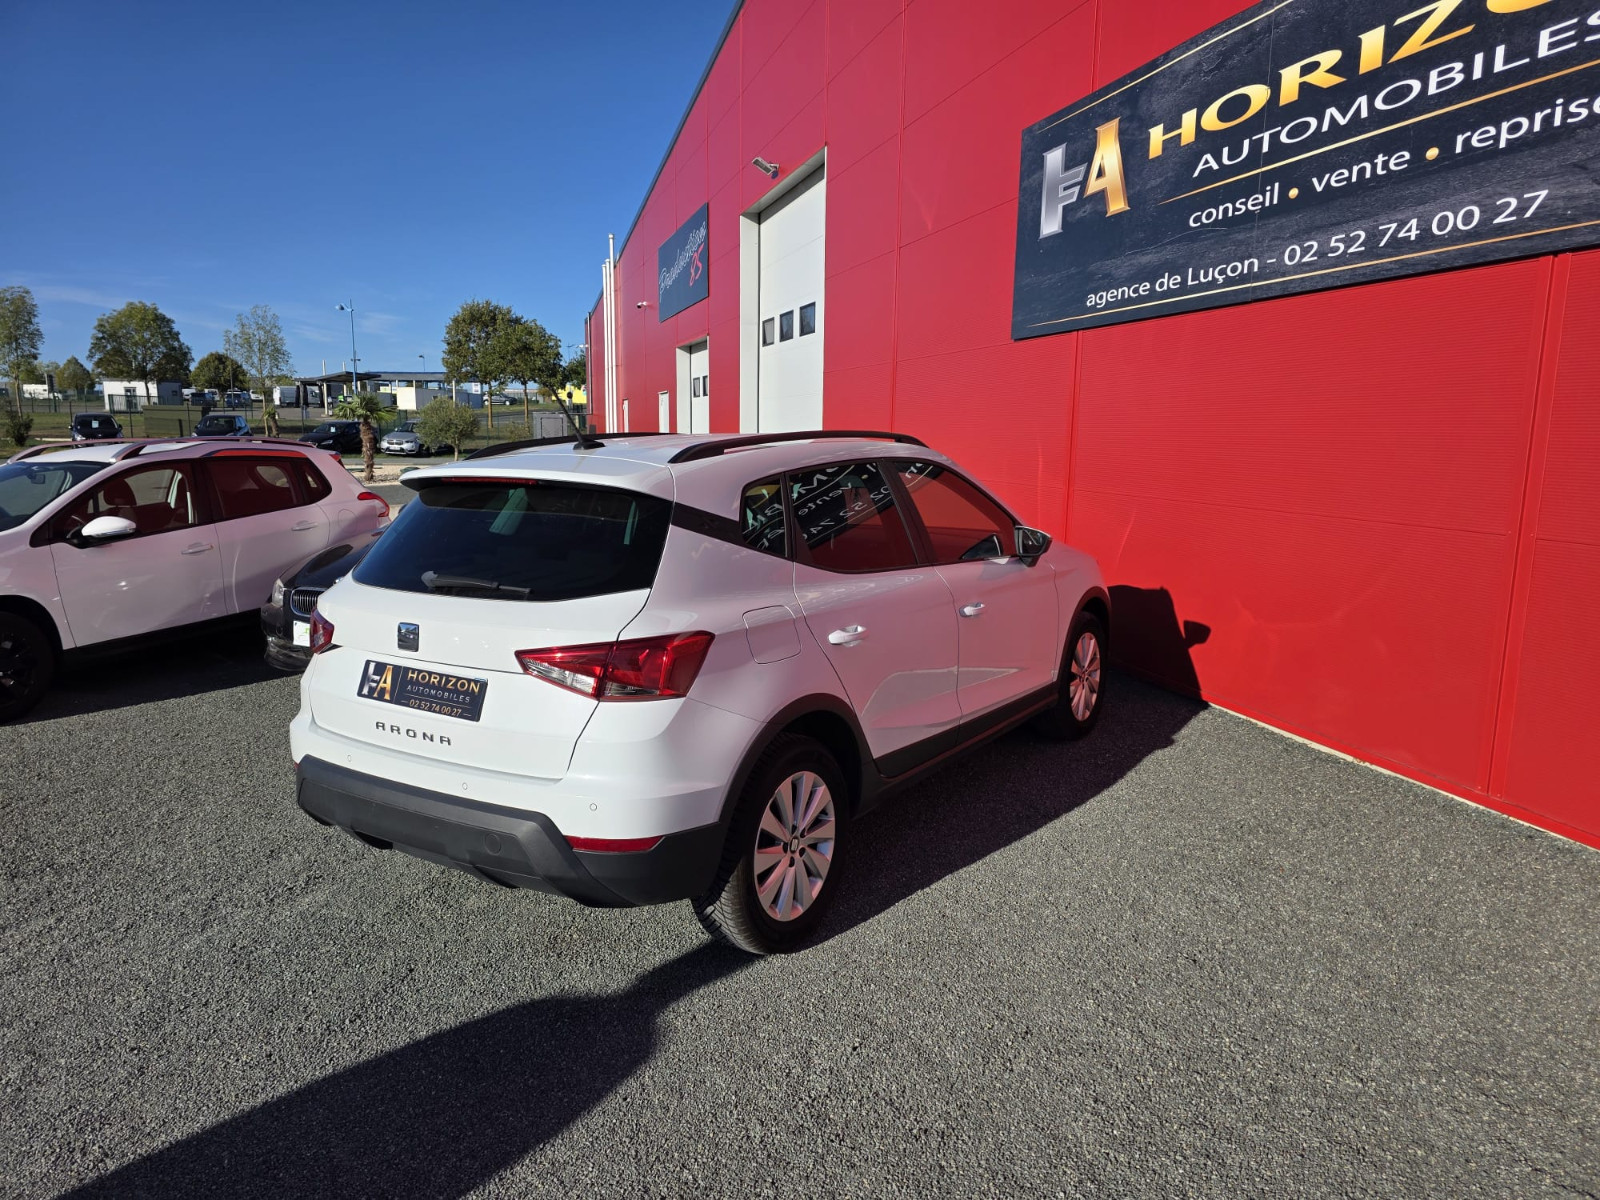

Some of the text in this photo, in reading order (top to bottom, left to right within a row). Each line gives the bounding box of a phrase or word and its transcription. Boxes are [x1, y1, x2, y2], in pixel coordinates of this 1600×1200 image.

[1148, 0, 1551, 160] HORIZ
[1188, 95, 1600, 228] conseil vente repris
[1086, 281, 1151, 308] agence
[1155, 272, 1181, 293] de
[1187, 257, 1259, 286] Luçon
[1283, 241, 1318, 265] 02
[1327, 230, 1366, 257] 52
[1377, 218, 1420, 247] 74
[1431, 205, 1481, 235] 00
[1492, 189, 1549, 224] 27
[406, 684, 471, 703] AUTOMOBILES
[407, 669, 480, 696] HORIZON
[375, 721, 452, 746] ARONA
